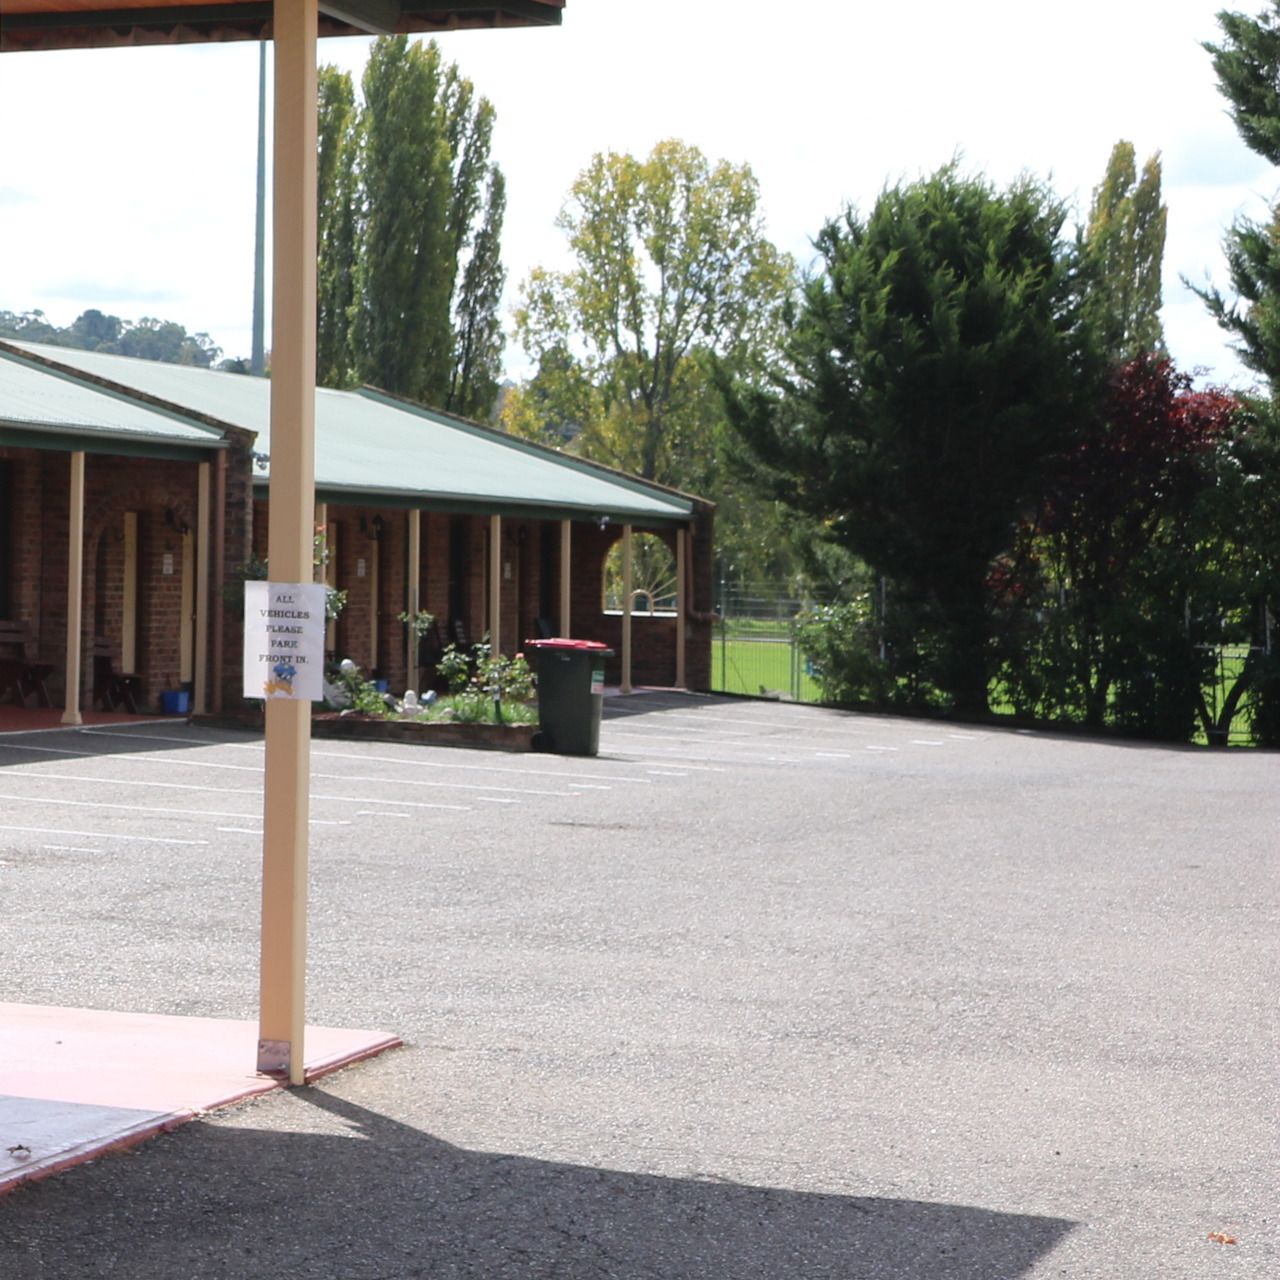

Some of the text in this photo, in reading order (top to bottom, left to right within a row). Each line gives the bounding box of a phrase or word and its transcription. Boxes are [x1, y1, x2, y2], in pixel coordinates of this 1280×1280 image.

[275, 595, 295, 604] ALL
[260, 609, 310, 619] VEHICLES
[266, 625, 303, 634] PLEASE
[271, 640, 298, 649] PARK
[258, 654, 293, 664] FRONT
